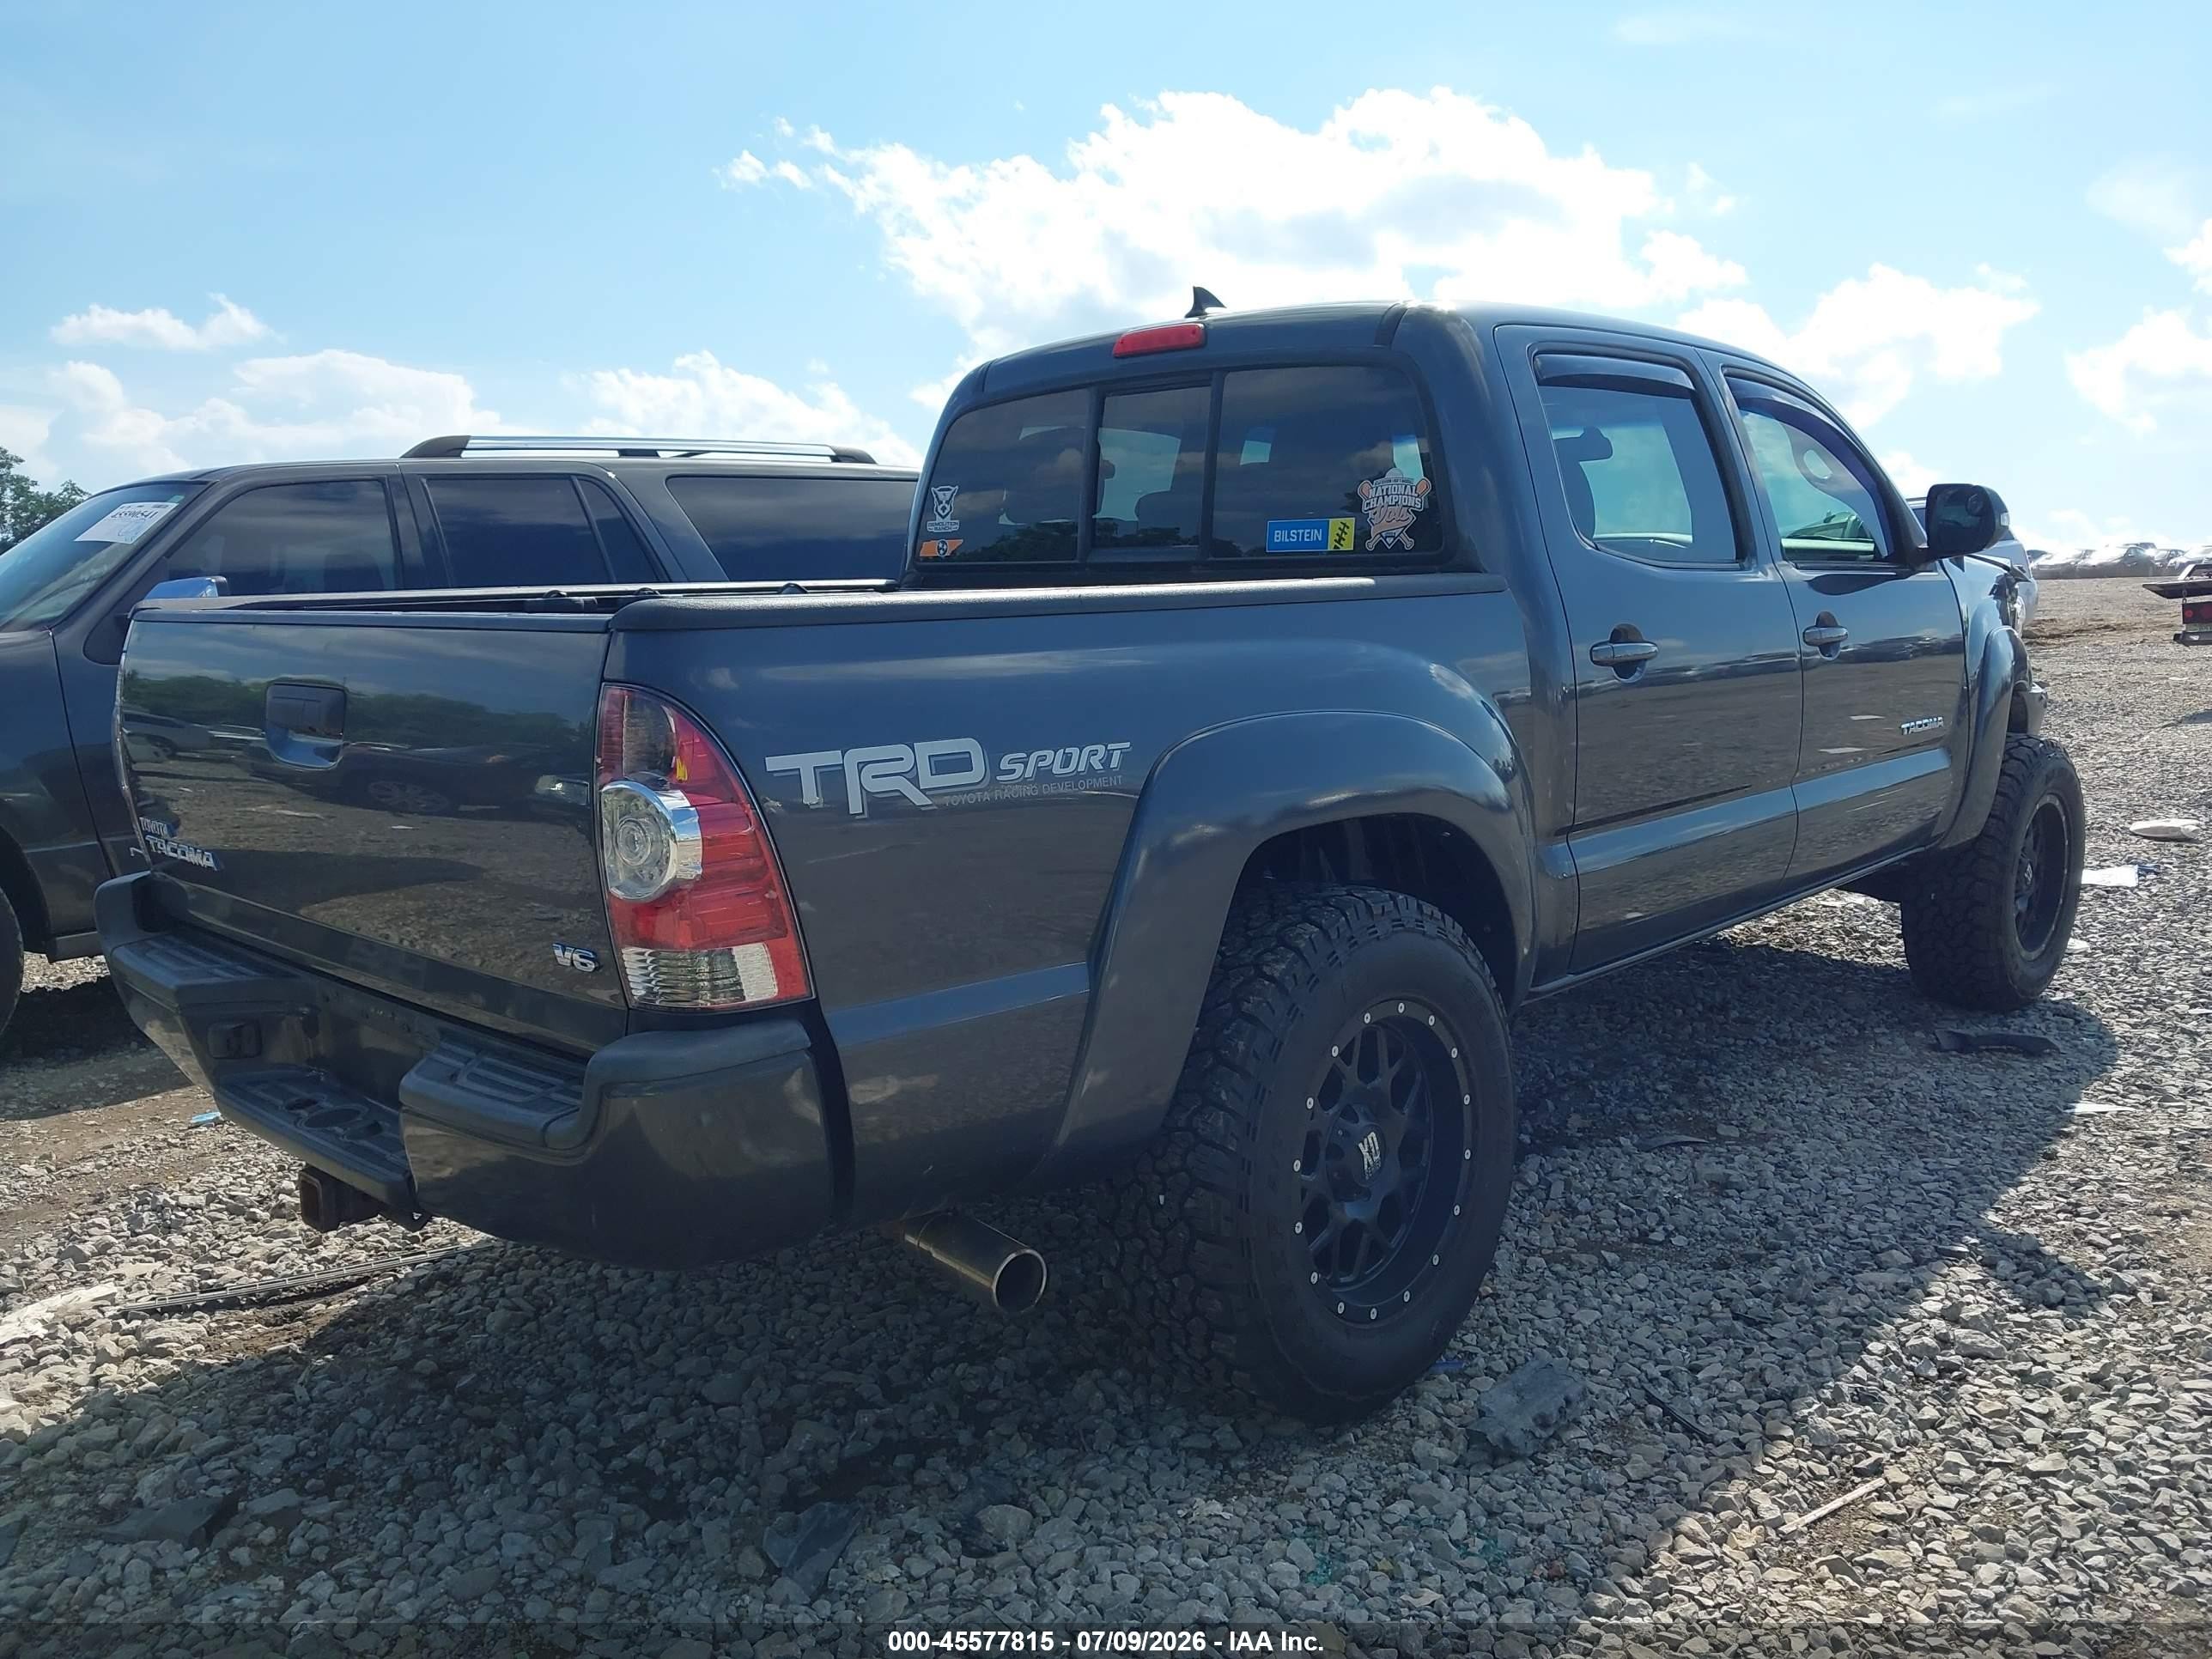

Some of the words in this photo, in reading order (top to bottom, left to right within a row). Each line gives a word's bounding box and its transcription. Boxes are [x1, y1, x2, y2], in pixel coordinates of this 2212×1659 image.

[1369, 484, 1418, 498] NATIONAL
[1364, 495, 1422, 510] CHAMPIONS
[1273, 529, 1322, 543] BILSTEIN
[1900, 716, 1944, 735] TACOMA
[764, 738, 990, 819] TRD
[996, 742, 1132, 781] SPORT
[945, 792, 990, 807] TOYOTA
[994, 785, 1039, 801] RACING
[1042, 775, 1123, 793] DEVELOPMENT
[139, 817, 168, 836] TOYOTA
[145, 835, 218, 871] TACOMA
[552, 943, 597, 972] V6
